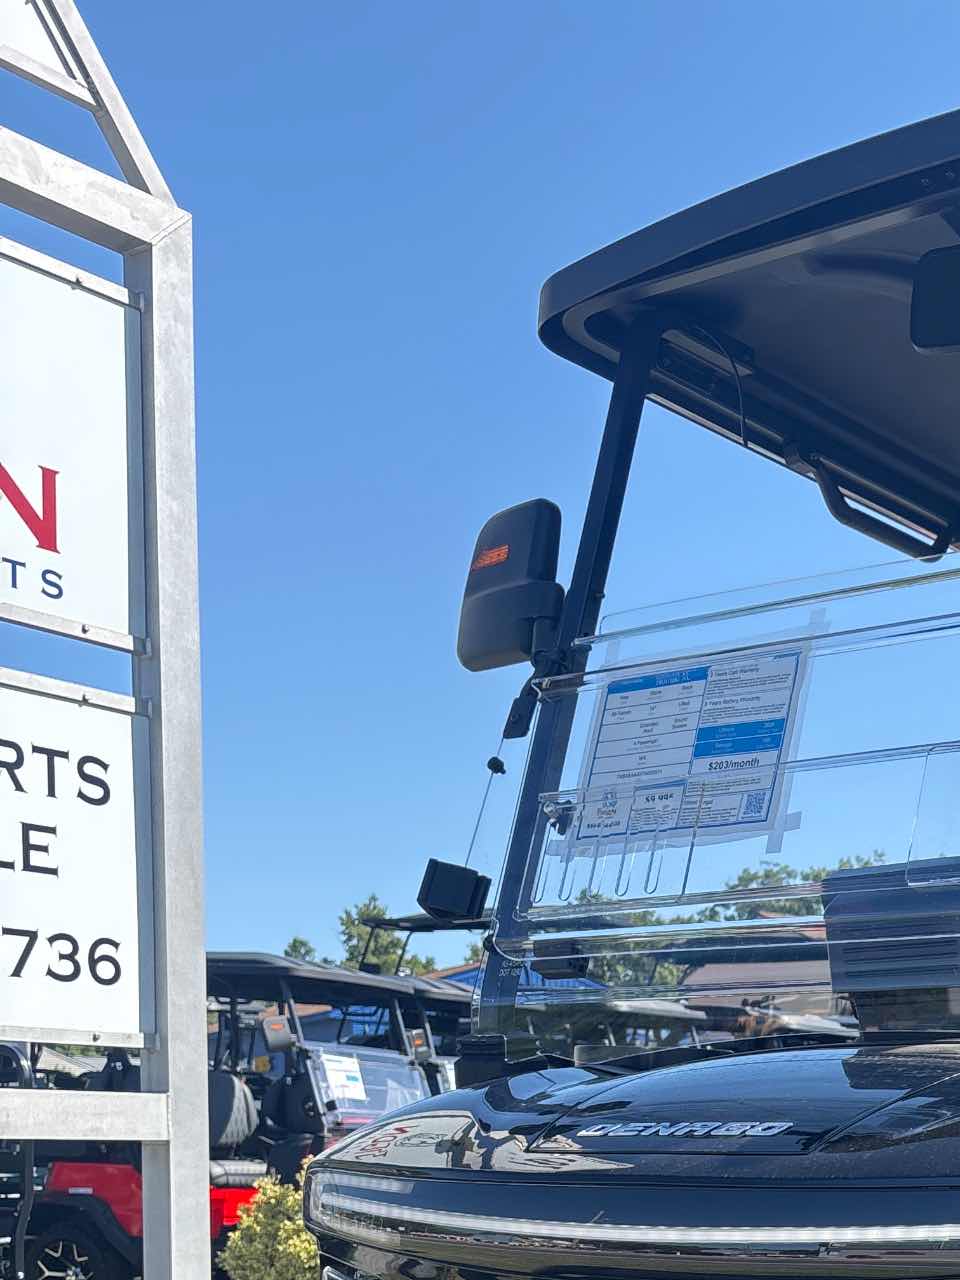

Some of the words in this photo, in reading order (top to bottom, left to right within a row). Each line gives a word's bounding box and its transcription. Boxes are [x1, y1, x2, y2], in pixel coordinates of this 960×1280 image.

[708, 757, 760, 771] $203/month
[0, 820, 59, 878] E
[576, 1121, 794, 1137] DENAGO
